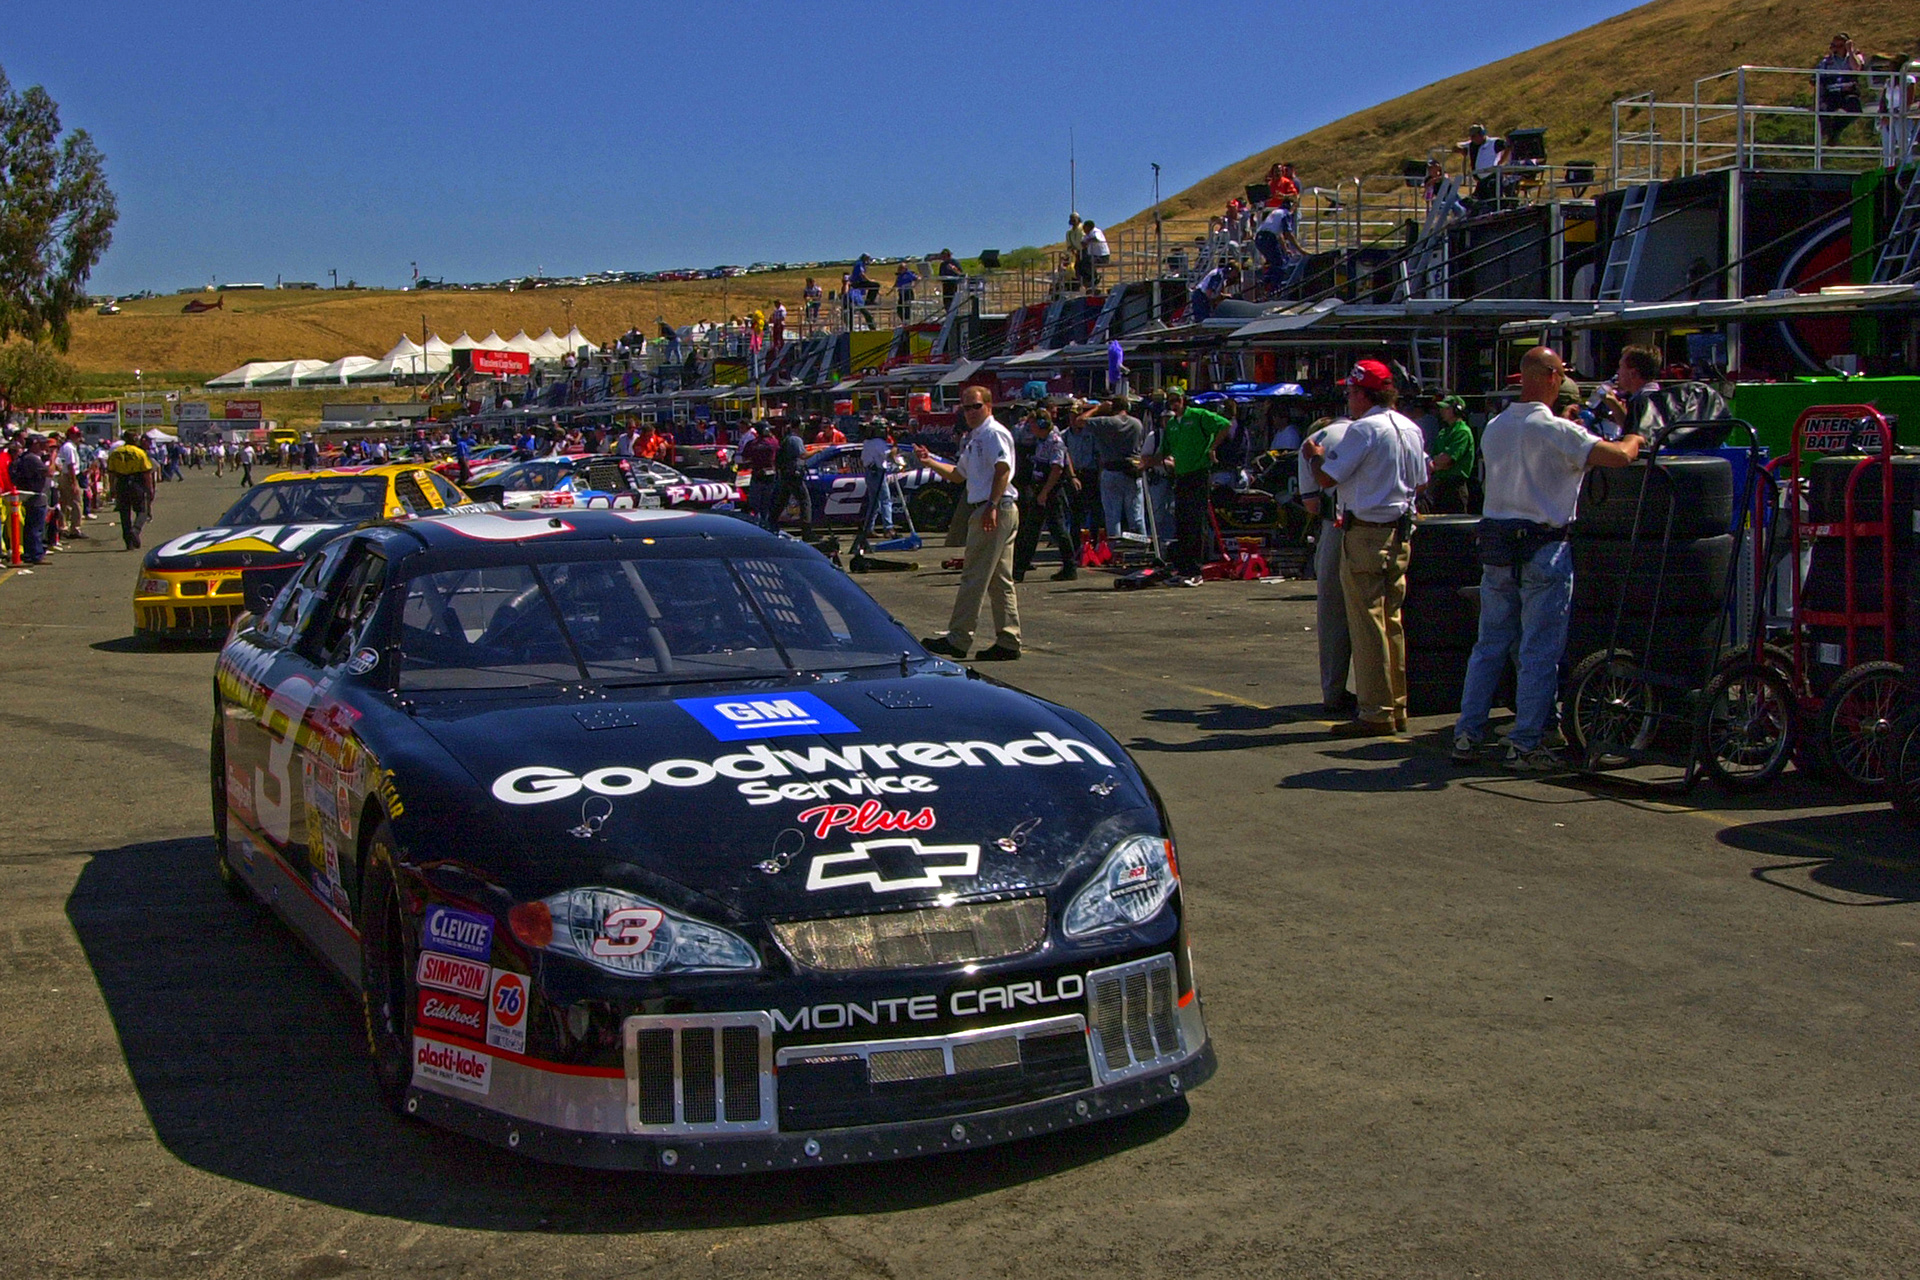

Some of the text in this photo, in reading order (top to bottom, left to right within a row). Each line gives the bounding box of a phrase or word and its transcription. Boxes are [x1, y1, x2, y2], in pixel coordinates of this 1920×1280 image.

[1804, 418, 1897, 433] INTERSA
[1805, 434, 1883, 451] BATTRIE
[157, 524, 344, 557] CAT
[194, 570, 240, 579] PONTIAC
[714, 699, 811, 723] GM
[492, 731, 1115, 805] Goodwrench
[738, 770, 939, 806] Service
[797, 799, 937, 839] Plus
[430, 909, 490, 946] CLEVITE
[592, 906, 664, 957] 3
[424, 957, 485, 992] SIMPSON
[423, 998, 481, 1029] Edelbrock
[497, 986, 522, 1016] 76
[770, 974, 1083, 1032] MONTE CARLO
[418, 1044, 485, 1080] plasti-kote
